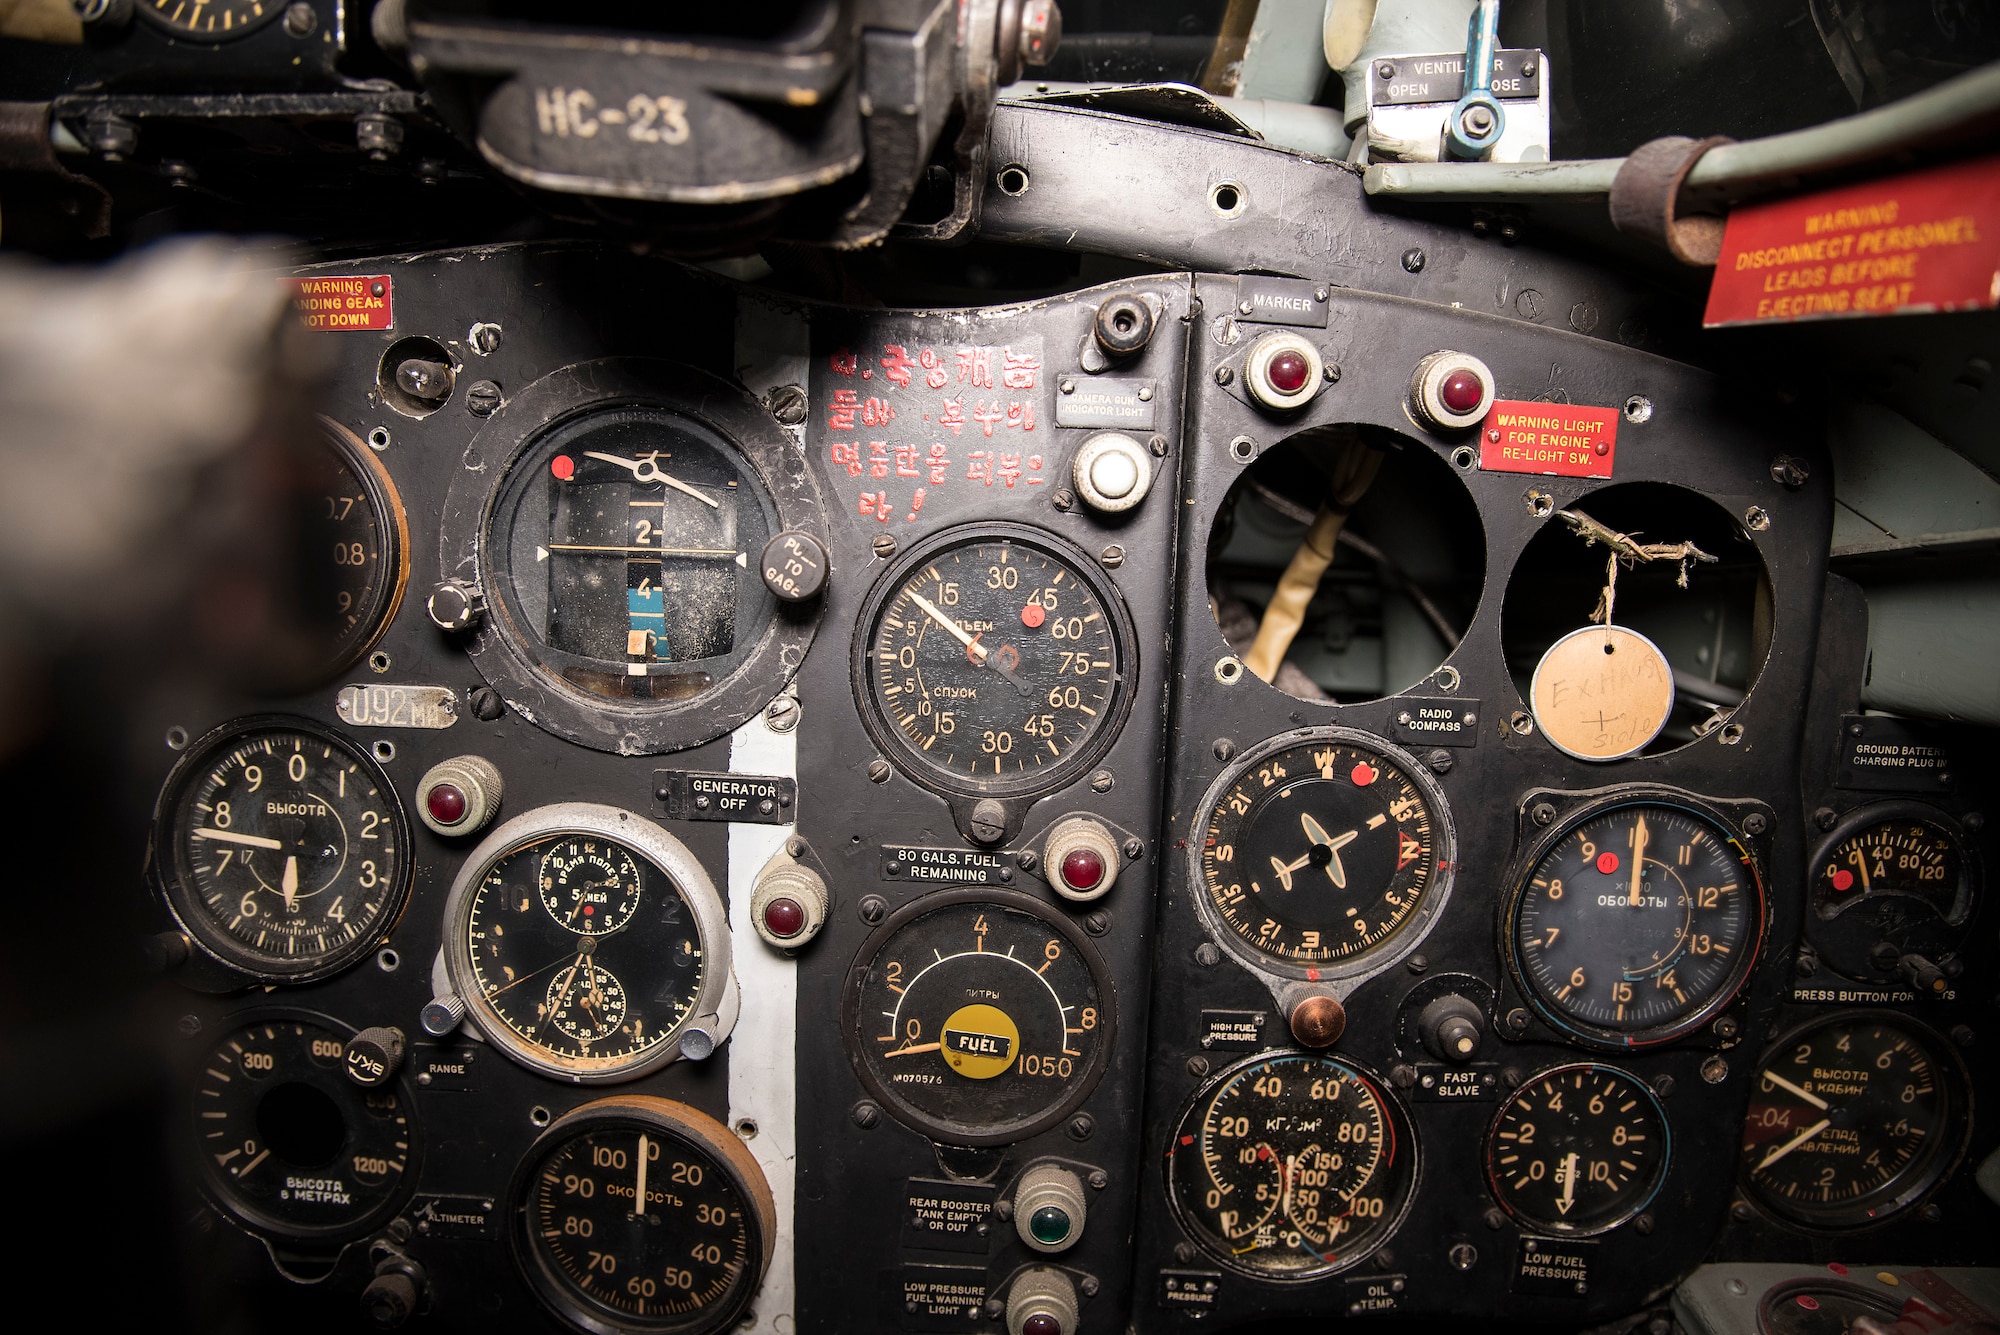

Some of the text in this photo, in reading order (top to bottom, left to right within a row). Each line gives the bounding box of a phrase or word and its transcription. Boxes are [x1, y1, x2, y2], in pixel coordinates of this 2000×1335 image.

[1389, 84, 1429, 97] OPEN
[1805, 200, 1899, 236] WARNING
[1735, 216, 1980, 271] DISCONNECT PERSONEL
[1764, 252, 1919, 293] LEADS BEFORE
[301, 281, 363, 294] WARNING
[346, 297, 383, 309] GEAR
[1254, 294, 1312, 312] MARKER
[1757, 282, 1915, 318] EJECTING SEAT
[330, 313, 370, 326] DOWN
[1072, 393, 1135, 405] CAMERA GUN
[1062, 404, 1145, 417] INDICATOR LIGHT
[1497, 414, 1604, 434] WARNING LIGHT
[1508, 432, 1591, 449] FOR ENGINE
[1502, 447, 1593, 465] RE-LIGHT SW.
[636, 519, 652, 544] 2
[334, 543, 365, 566] 0.8
[986, 566, 1018, 590] 30
[637, 578, 651, 600] 4
[938, 582, 960, 606] 15
[1027, 588, 1058, 611] 45
[906, 621, 917, 636] 5
[1051, 617, 1083, 639] 60
[899, 646, 915, 669] 0
[1058, 651, 1090, 675] 75
[904, 678, 915, 694] 5
[933, 686, 977, 699] СПУСК
[1048, 686, 1080, 709] 60
[917, 700, 932, 717] 10
[1419, 708, 1453, 719] RADIO
[934, 711, 955, 735] 15
[1023, 714, 1055, 738] 45
[1408, 720, 1461, 732] COMPASS
[981, 731, 1013, 754] 30
[1855, 744, 1899, 755] GROUND
[289, 754, 306, 782] 0
[1852, 756, 1948, 768] CHARGING PLUG IN
[244, 765, 263, 793] 9
[1258, 762, 1287, 788] 24
[693, 779, 776, 797] GENERATOR
[266, 802, 327, 817] ВЫСОТА
[719, 798, 748, 811] OFF
[1230, 792, 1252, 816] 21
[214, 801, 232, 829] 8
[360, 811, 379, 839] 2
[215, 850, 234, 877] 7
[898, 850, 1001, 867] 80 GALS. FUEL
[1678, 845, 1691, 866] 11
[1872, 847, 1893, 860] 40
[1899, 854, 1920, 869] 80
[359, 860, 377, 888] 3
[910, 866, 987, 881] REMAINING
[1919, 866, 1945, 880] 120
[240, 890, 258, 918] 6
[1698, 886, 1718, 908] 12
[327, 896, 346, 924] 4
[973, 914, 989, 936] 4
[1044, 939, 1061, 960] 6
[1691, 934, 1711, 955] 13
[886, 961, 902, 983] 2
[1656, 969, 1676, 989] 14
[1612, 982, 1632, 1002] 15
[1794, 989, 1836, 1001] PRESS
[1838, 990, 1889, 1002] BUTTON
[1891, 991, 1915, 1002] FOR
[1081, 1007, 1097, 1030] 8
[1210, 1022, 1258, 1033] HIGH FUEL
[906, 1018, 921, 1040] 0
[1209, 1032, 1257, 1042] PRESSURE
[311, 1040, 343, 1058] 600
[958, 1035, 999, 1054] FUEL
[244, 1053, 274, 1071] 300
[429, 1063, 466, 1075] RANGE
[1018, 1054, 1073, 1078] 1050
[1443, 1072, 1477, 1083] FAST
[1812, 1067, 1869, 1082] ВЫСОТА
[1253, 1076, 1282, 1098] 40
[1311, 1079, 1341, 1101] 60
[1438, 1085, 1480, 1097] SLAVE
[1817, 1082, 1867, 1096] КАБИН
[1548, 1091, 1563, 1112] 4
[1589, 1094, 1604, 1115] 6
[1220, 1117, 1249, 1137] 20
[1337, 1122, 1367, 1144] 80
[1518, 1122, 1536, 1144] 2
[1612, 1125, 1627, 1146] 8
[352, 1155, 388, 1176] 1200
[593, 1145, 627, 1169] 100
[1238, 1147, 1257, 1164] 10
[1314, 1152, 1343, 1171] 150
[671, 1161, 703, 1186] 20
[1301, 1169, 1328, 1187] 100
[1529, 1160, 1545, 1181] 0
[1588, 1160, 1610, 1182] 10
[286, 1177, 343, 1193] ВЫСОТА
[563, 1174, 595, 1198] 90
[1255, 1184, 1268, 1201] 5
[294, 1190, 351, 1206] МЕТРАХ
[606, 1184, 684, 1208] СКООСТЬ
[909, 1197, 991, 1213] REAR BOOSTER
[1206, 1190, 1220, 1209] 0
[1297, 1189, 1320, 1207] 50
[696, 1203, 726, 1226] 30
[916, 1208, 983, 1223] TANK EMPTY
[1349, 1197, 1383, 1219] 100
[427, 1213, 485, 1225] ALTIMETER
[564, 1216, 593, 1238] 80
[929, 1221, 969, 1232] OR OUT
[587, 1250, 616, 1274] 70
[691, 1242, 721, 1265] 40
[1525, 1252, 1587, 1268] LOW FUEL
[663, 1267, 693, 1290] 50
[1521, 1265, 1587, 1281] PRESSURE
[627, 1275, 656, 1298] 60
[904, 1282, 986, 1296] LOW PRESSURE
[1184, 1281, 1198, 1291] OIL
[1367, 1284, 1389, 1297] OIL
[905, 1293, 984, 1306] FUEL WARNING
[1166, 1290, 1214, 1303] PRESSURE
[1360, 1297, 1398, 1310] TEMP.
[928, 1305, 960, 1315] LIGHT
